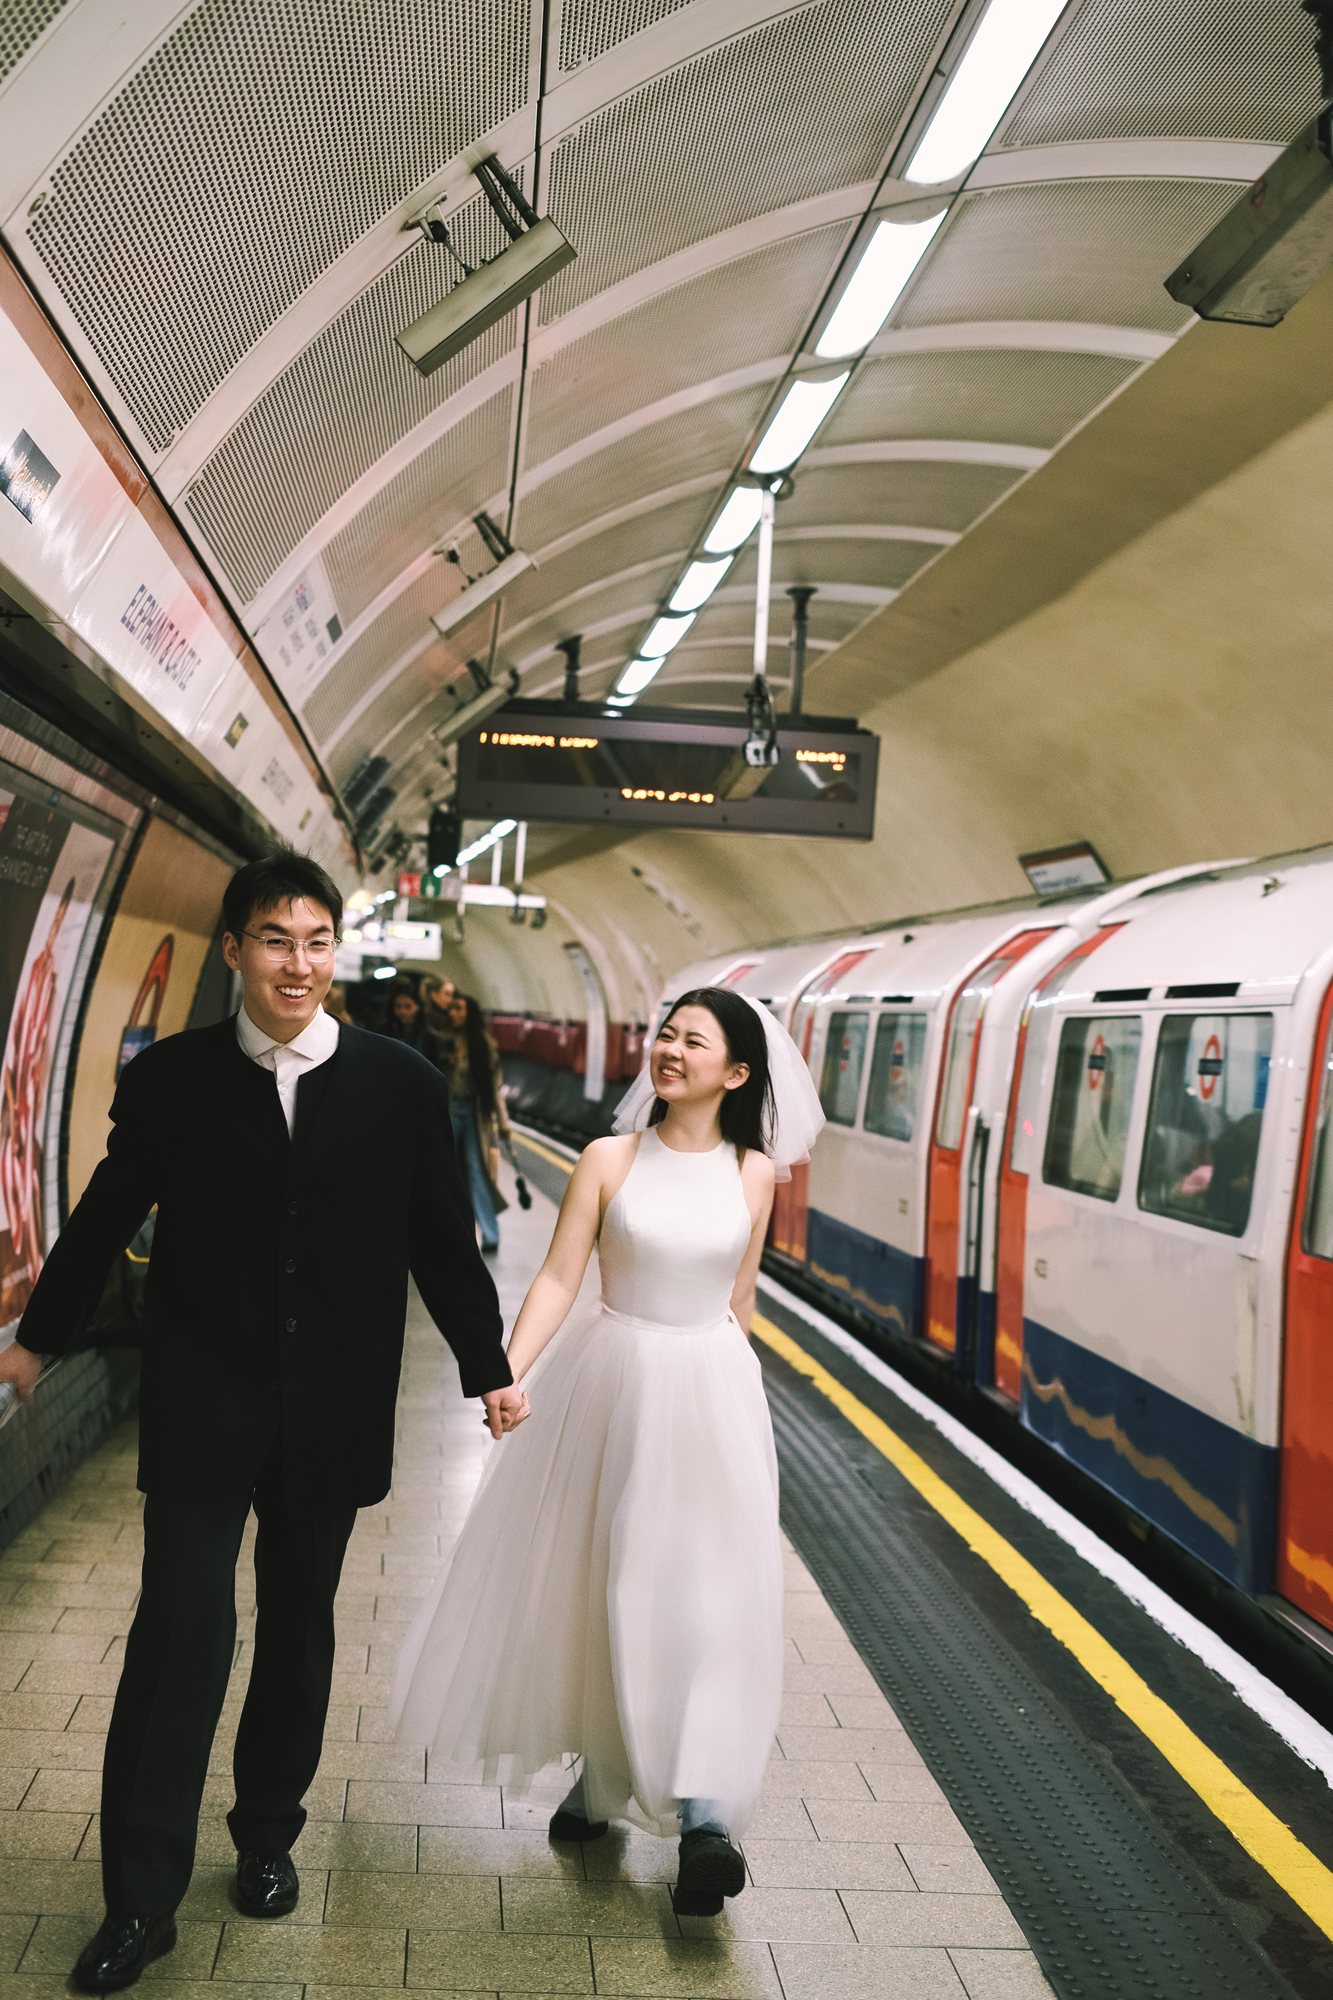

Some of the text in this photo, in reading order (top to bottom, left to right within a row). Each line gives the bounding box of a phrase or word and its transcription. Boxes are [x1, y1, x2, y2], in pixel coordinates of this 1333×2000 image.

[120, 584, 202, 692] ELEPHANT & CASTLE
